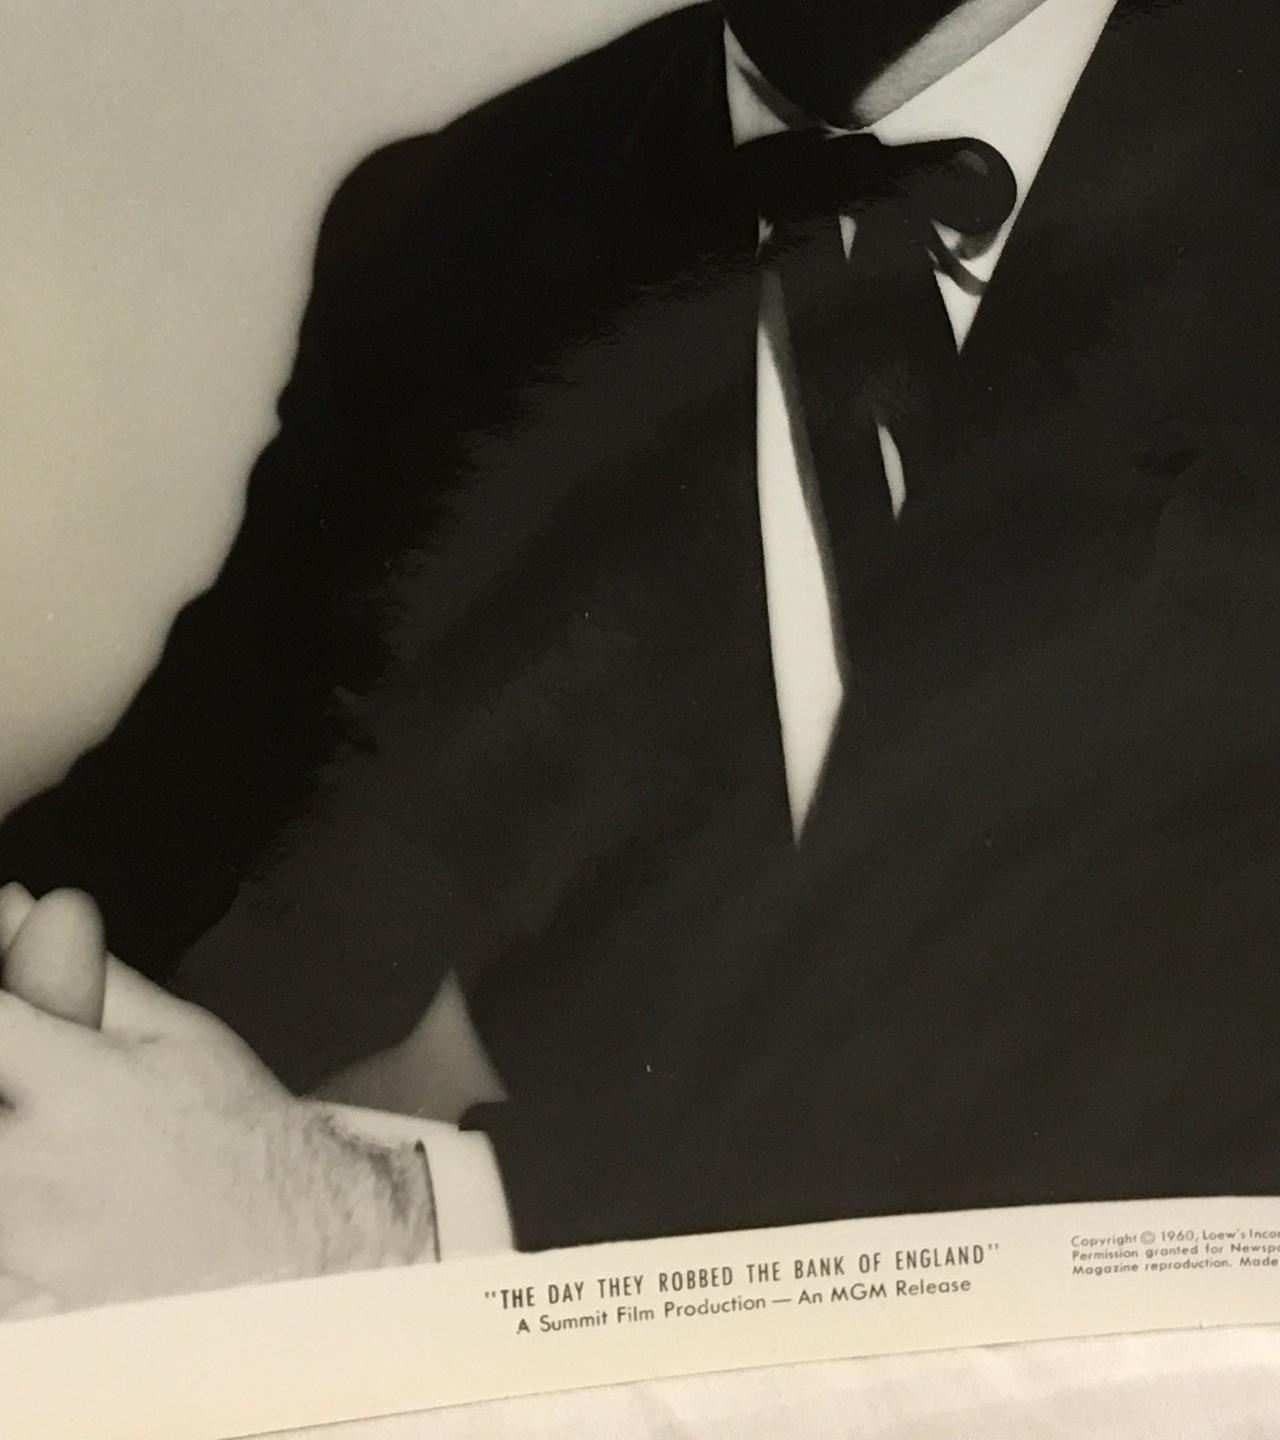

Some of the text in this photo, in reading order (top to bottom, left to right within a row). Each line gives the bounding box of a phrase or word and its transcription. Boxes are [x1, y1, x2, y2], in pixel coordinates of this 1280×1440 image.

[1071, 1234, 1137, 1248] Copyright
[1072, 1249, 1139, 1261] Permission
[1145, 1244, 1198, 1259] granted
[1205, 1244, 1223, 1254] for
[484, 1243, 1000, 1309] "THE DAY THEY ROBBED THE BANK OF ENGLAND"
[1072, 1262, 1139, 1276] Magazine
[1144, 1257, 1232, 1272] reproduction.
[1239, 1257, 1279, 1267] Made
[516, 1317, 531, 1335] A
[539, 1309, 609, 1332] Summit
[616, 1305, 655, 1324] Film
[664, 1293, 767, 1318] Production
[797, 1289, 823, 1305] An
[830, 1282, 888, 1303] MGM
[895, 1277, 973, 1297] Release
